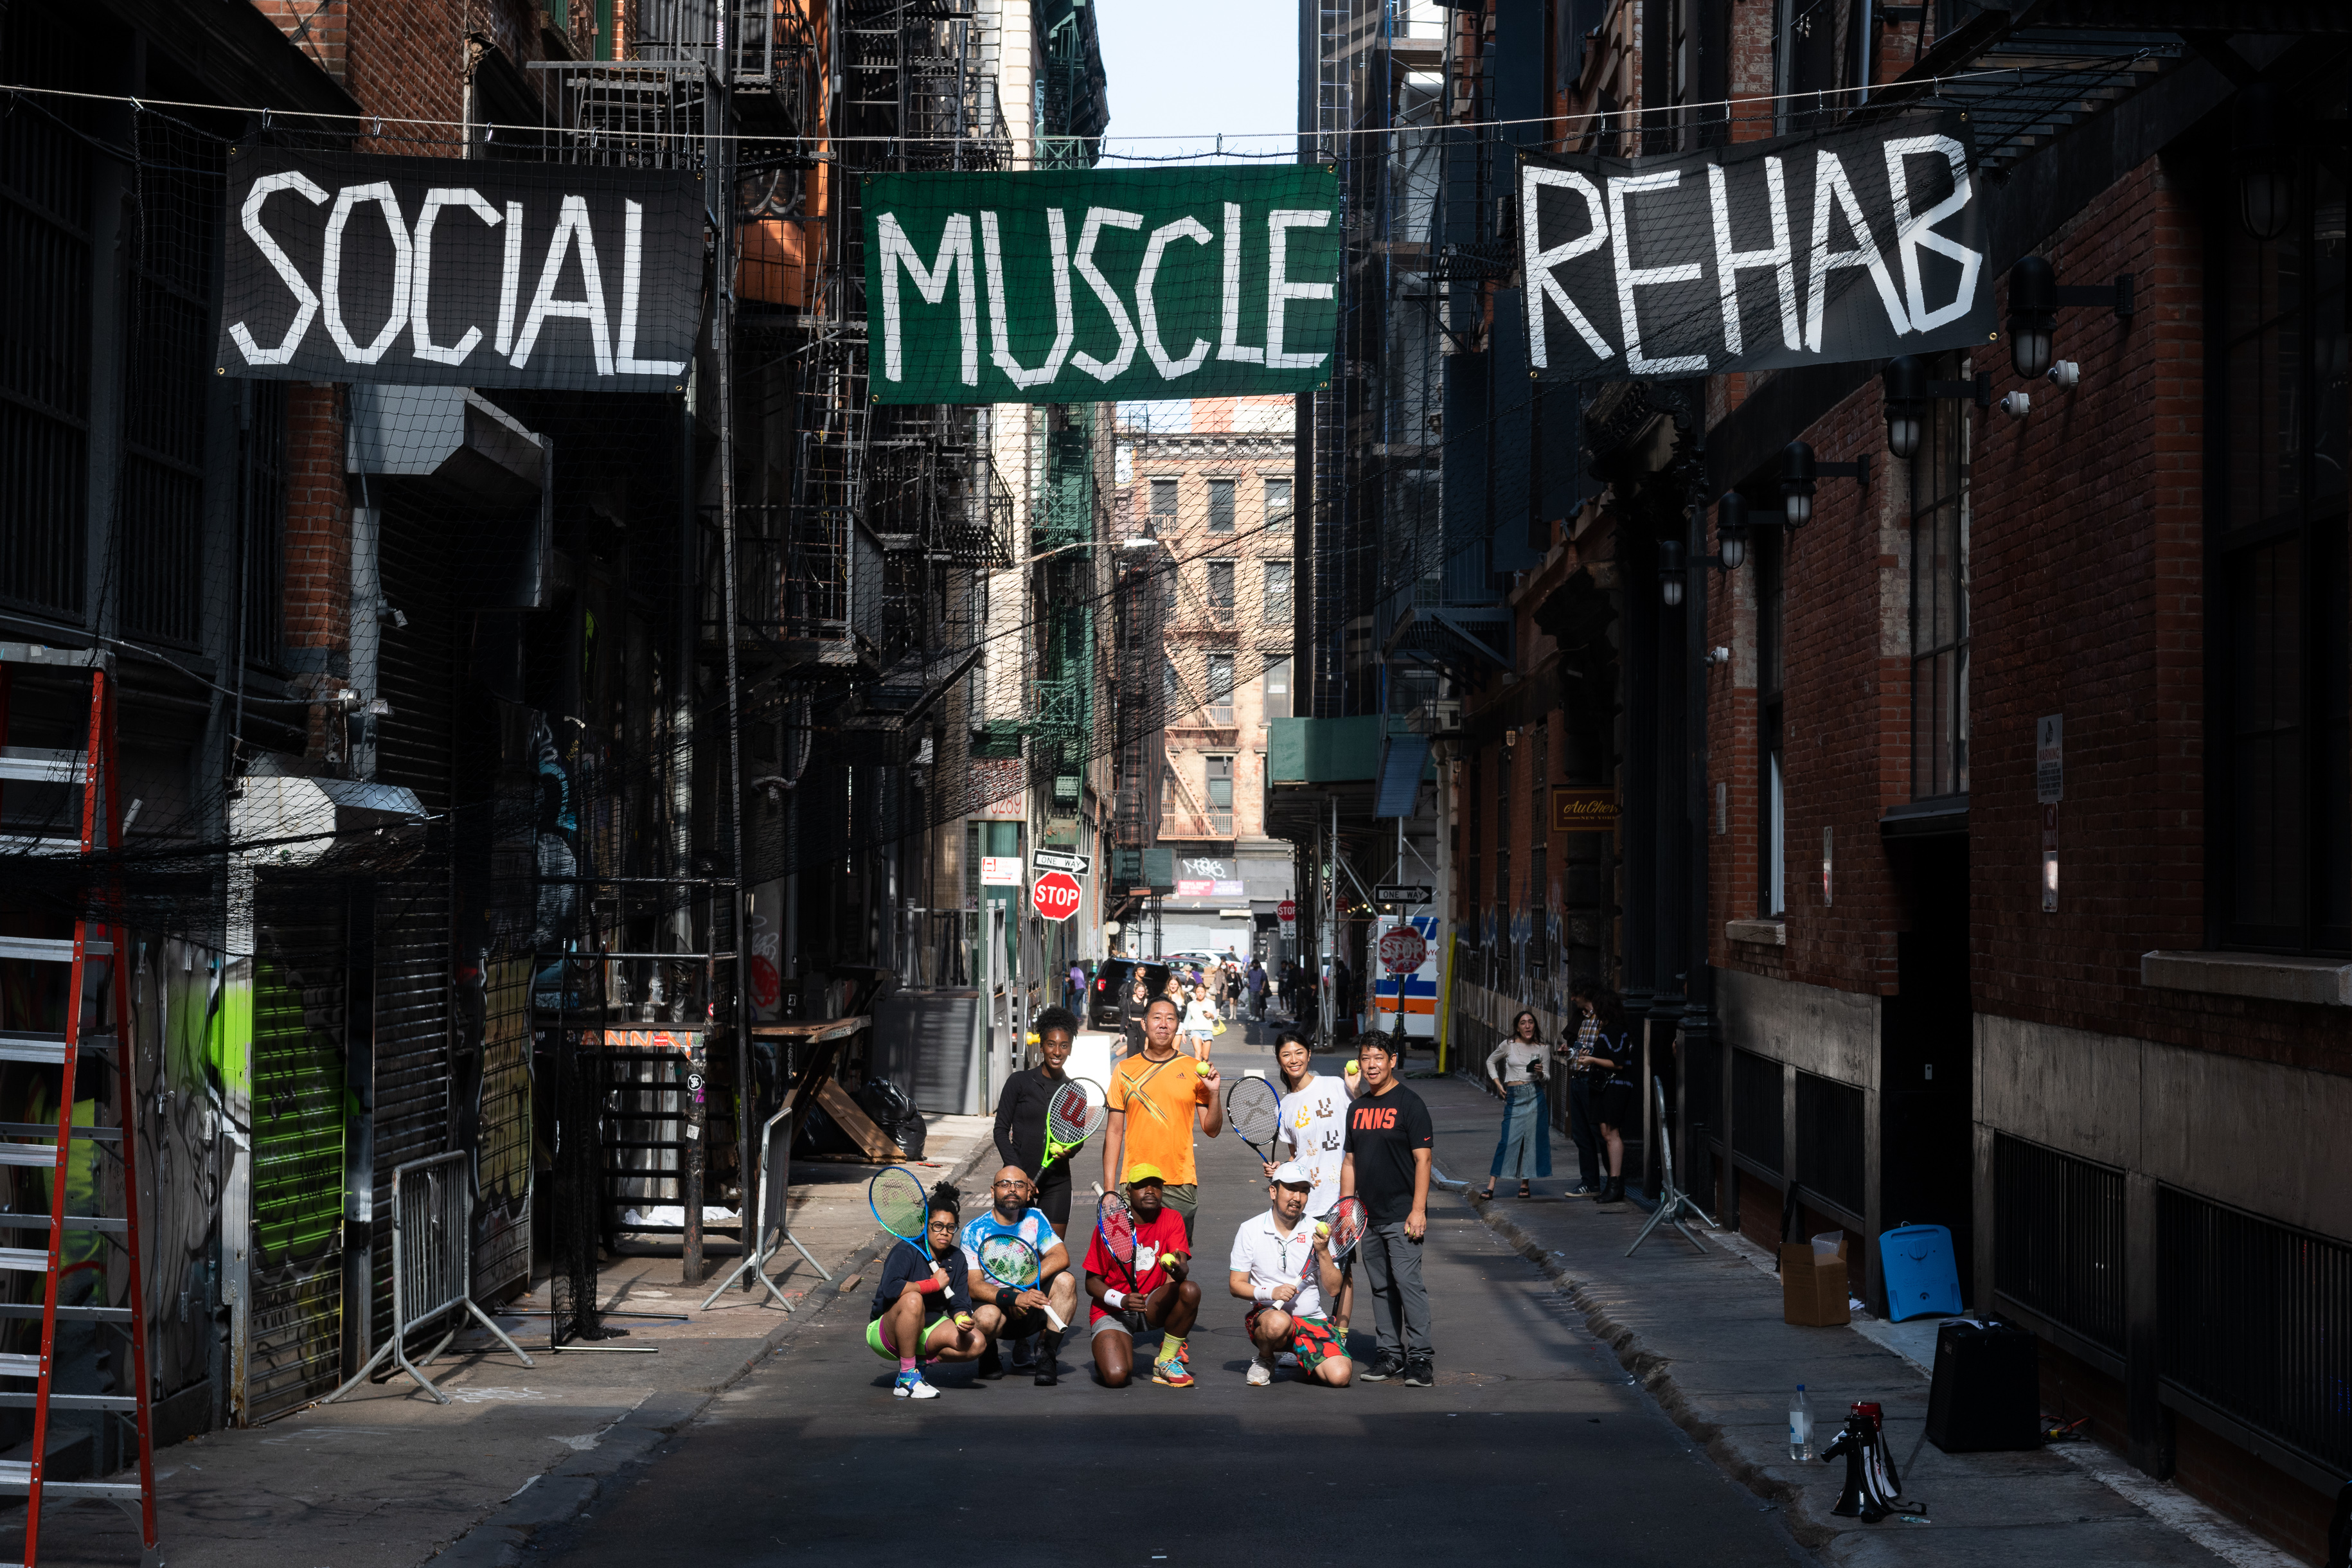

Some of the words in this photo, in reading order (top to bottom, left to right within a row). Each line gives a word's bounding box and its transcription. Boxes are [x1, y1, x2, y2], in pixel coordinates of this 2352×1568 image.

[229, 170, 687, 375] SOCIAL
[877, 202, 1335, 391] MUSCLE
[1522, 134, 1982, 374] REHAB
[2038, 746, 2061, 762] WARNING!
[1041, 856, 1058, 865] ONE
[1065, 859, 1082, 868] WAY
[1035, 884, 1078, 906] STOP
[1382, 941, 1425, 958] STOP
[1353, 1108, 1398, 1130] TNNS
